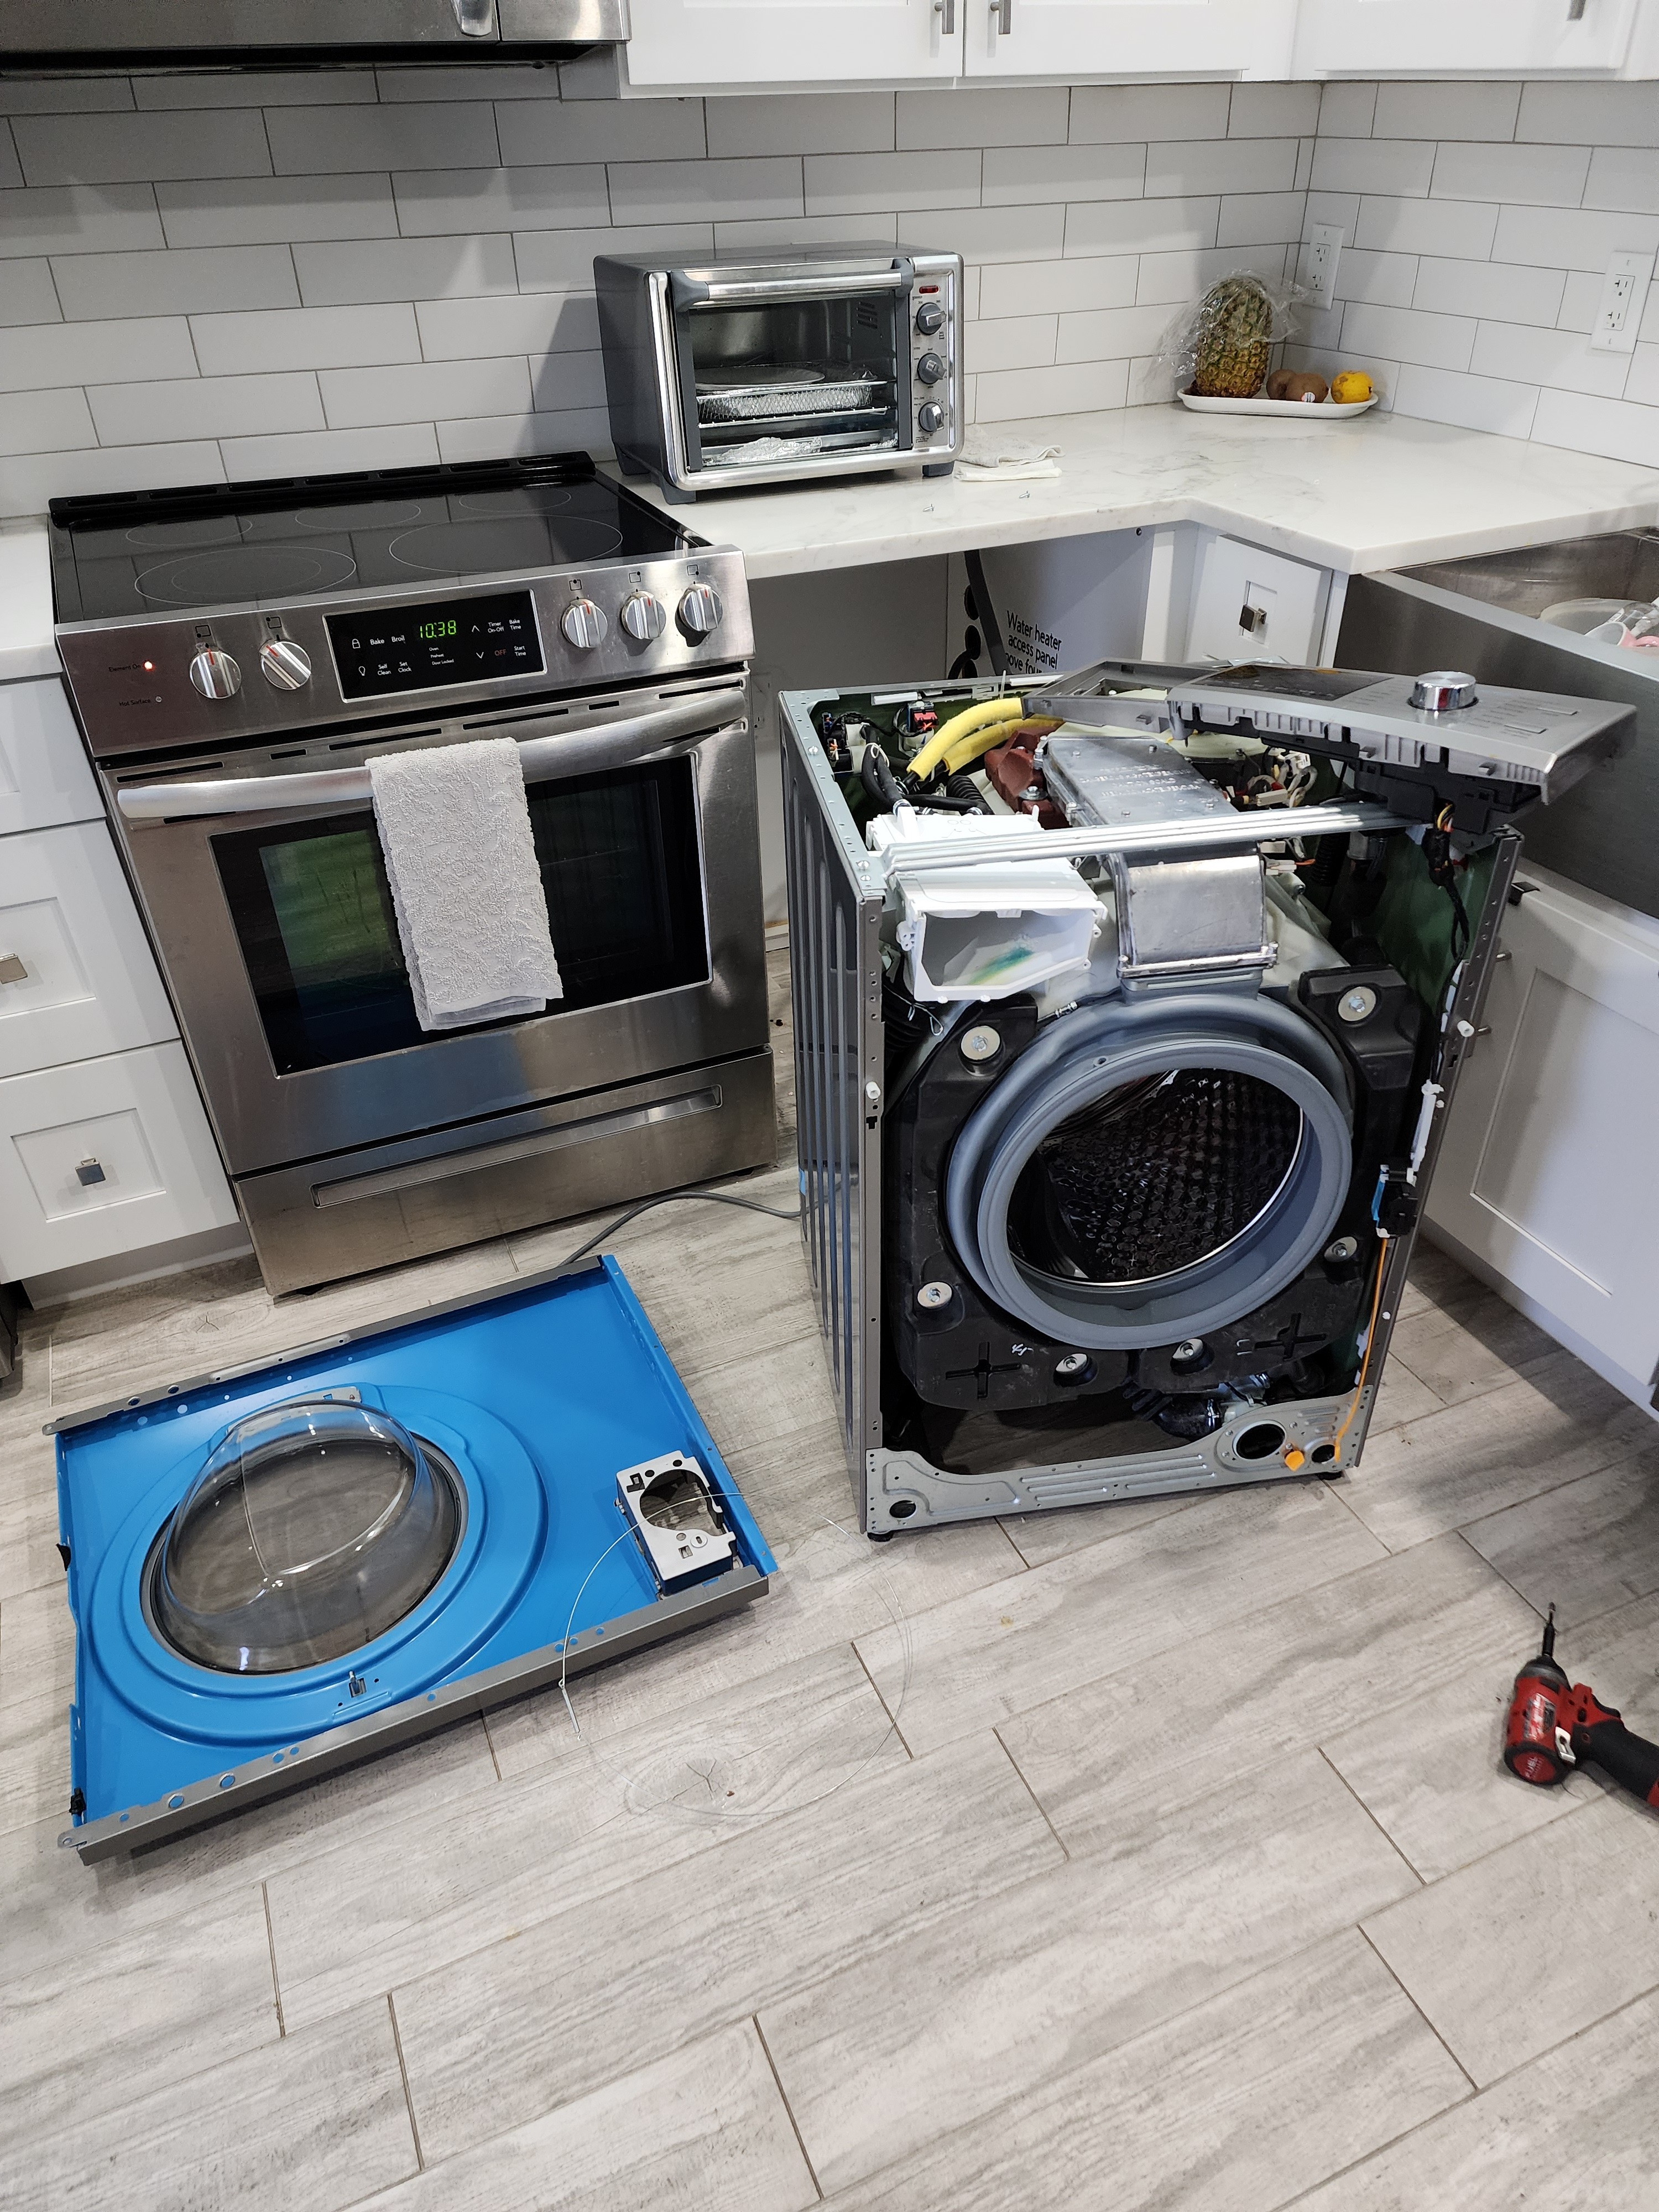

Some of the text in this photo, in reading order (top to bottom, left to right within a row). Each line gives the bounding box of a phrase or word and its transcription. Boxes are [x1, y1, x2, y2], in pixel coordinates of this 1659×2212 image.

[1007, 610, 1062, 651] Water heater
[1008, 634, 1058, 670] access panel
